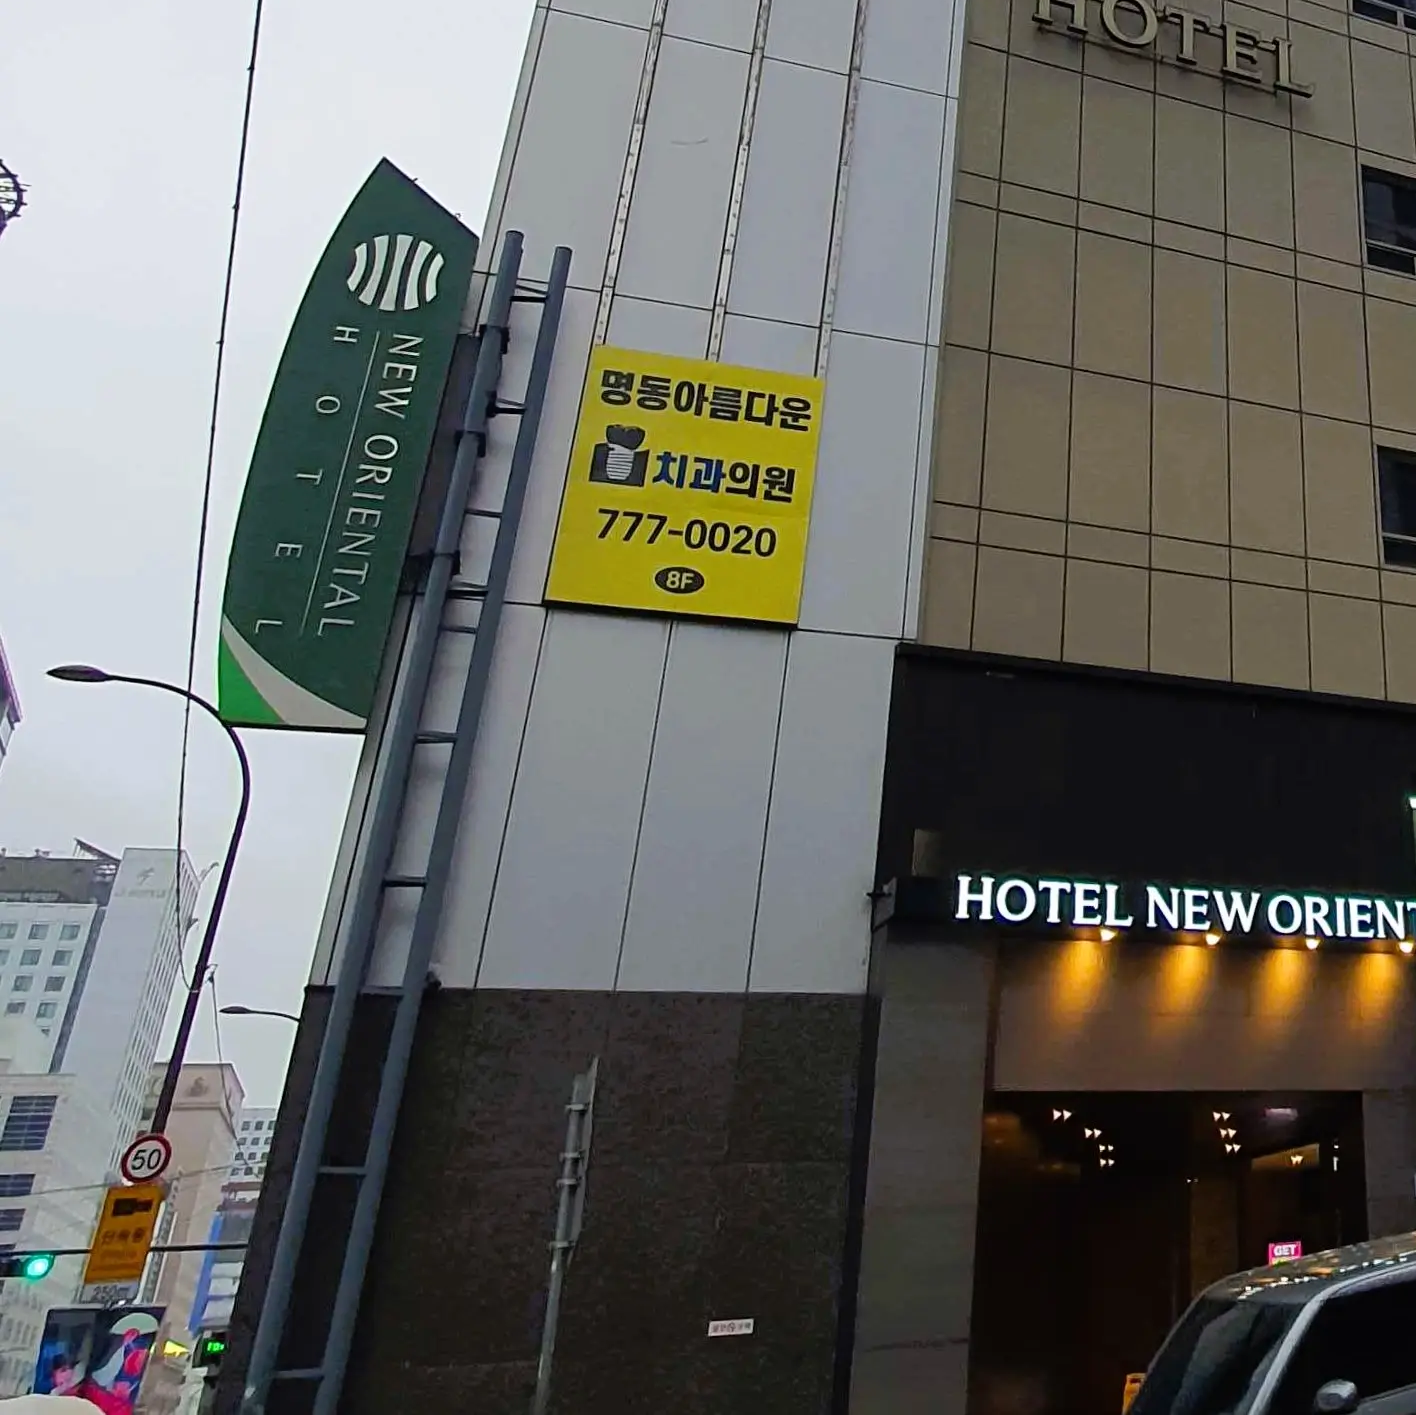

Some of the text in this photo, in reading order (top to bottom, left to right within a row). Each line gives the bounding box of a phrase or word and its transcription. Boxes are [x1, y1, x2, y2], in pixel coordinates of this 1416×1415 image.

[600, 369, 812, 432] 명동아름다운
[317, 333, 424, 637] NEW ORIENTAL
[652, 451, 796, 504] 치과의원
[597, 507, 777, 557] 777-0020
[665, 570, 696, 590] 8F
[955, 875, 1134, 927] HOTEL
[1145, 885, 1261, 934] NEW
[131, 1148, 162, 1171] 50
[1273, 1244, 1297, 1257] GET
